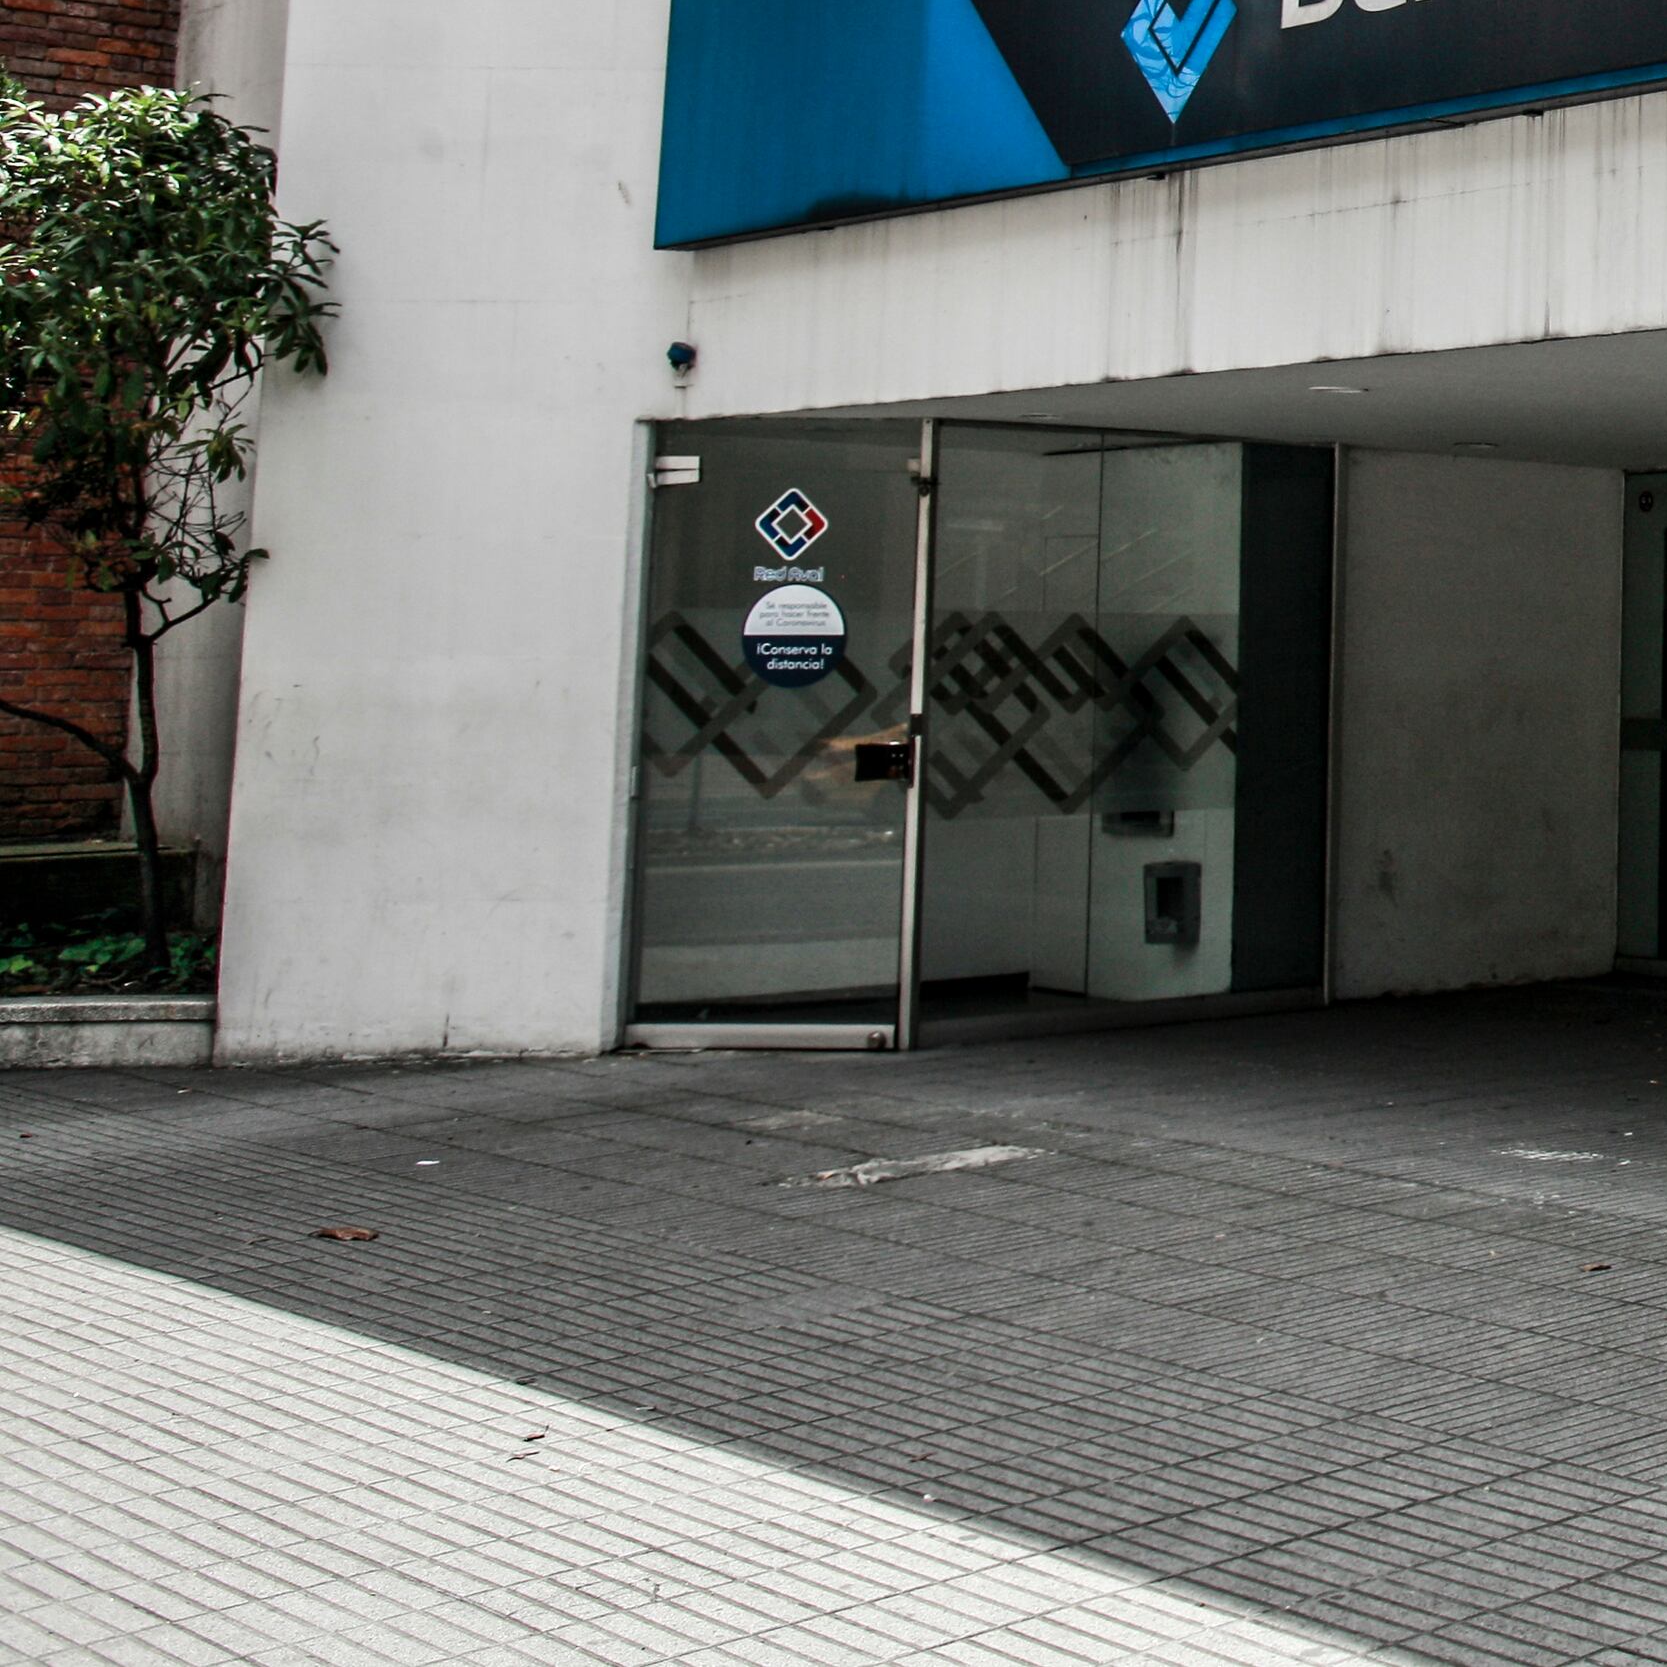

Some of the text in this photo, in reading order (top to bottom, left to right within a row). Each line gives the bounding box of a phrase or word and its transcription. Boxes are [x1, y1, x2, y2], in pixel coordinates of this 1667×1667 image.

[753, 566, 824, 582] Red Aval
[821, 643, 833, 655] la
[767, 658, 824, 670] distancia!
